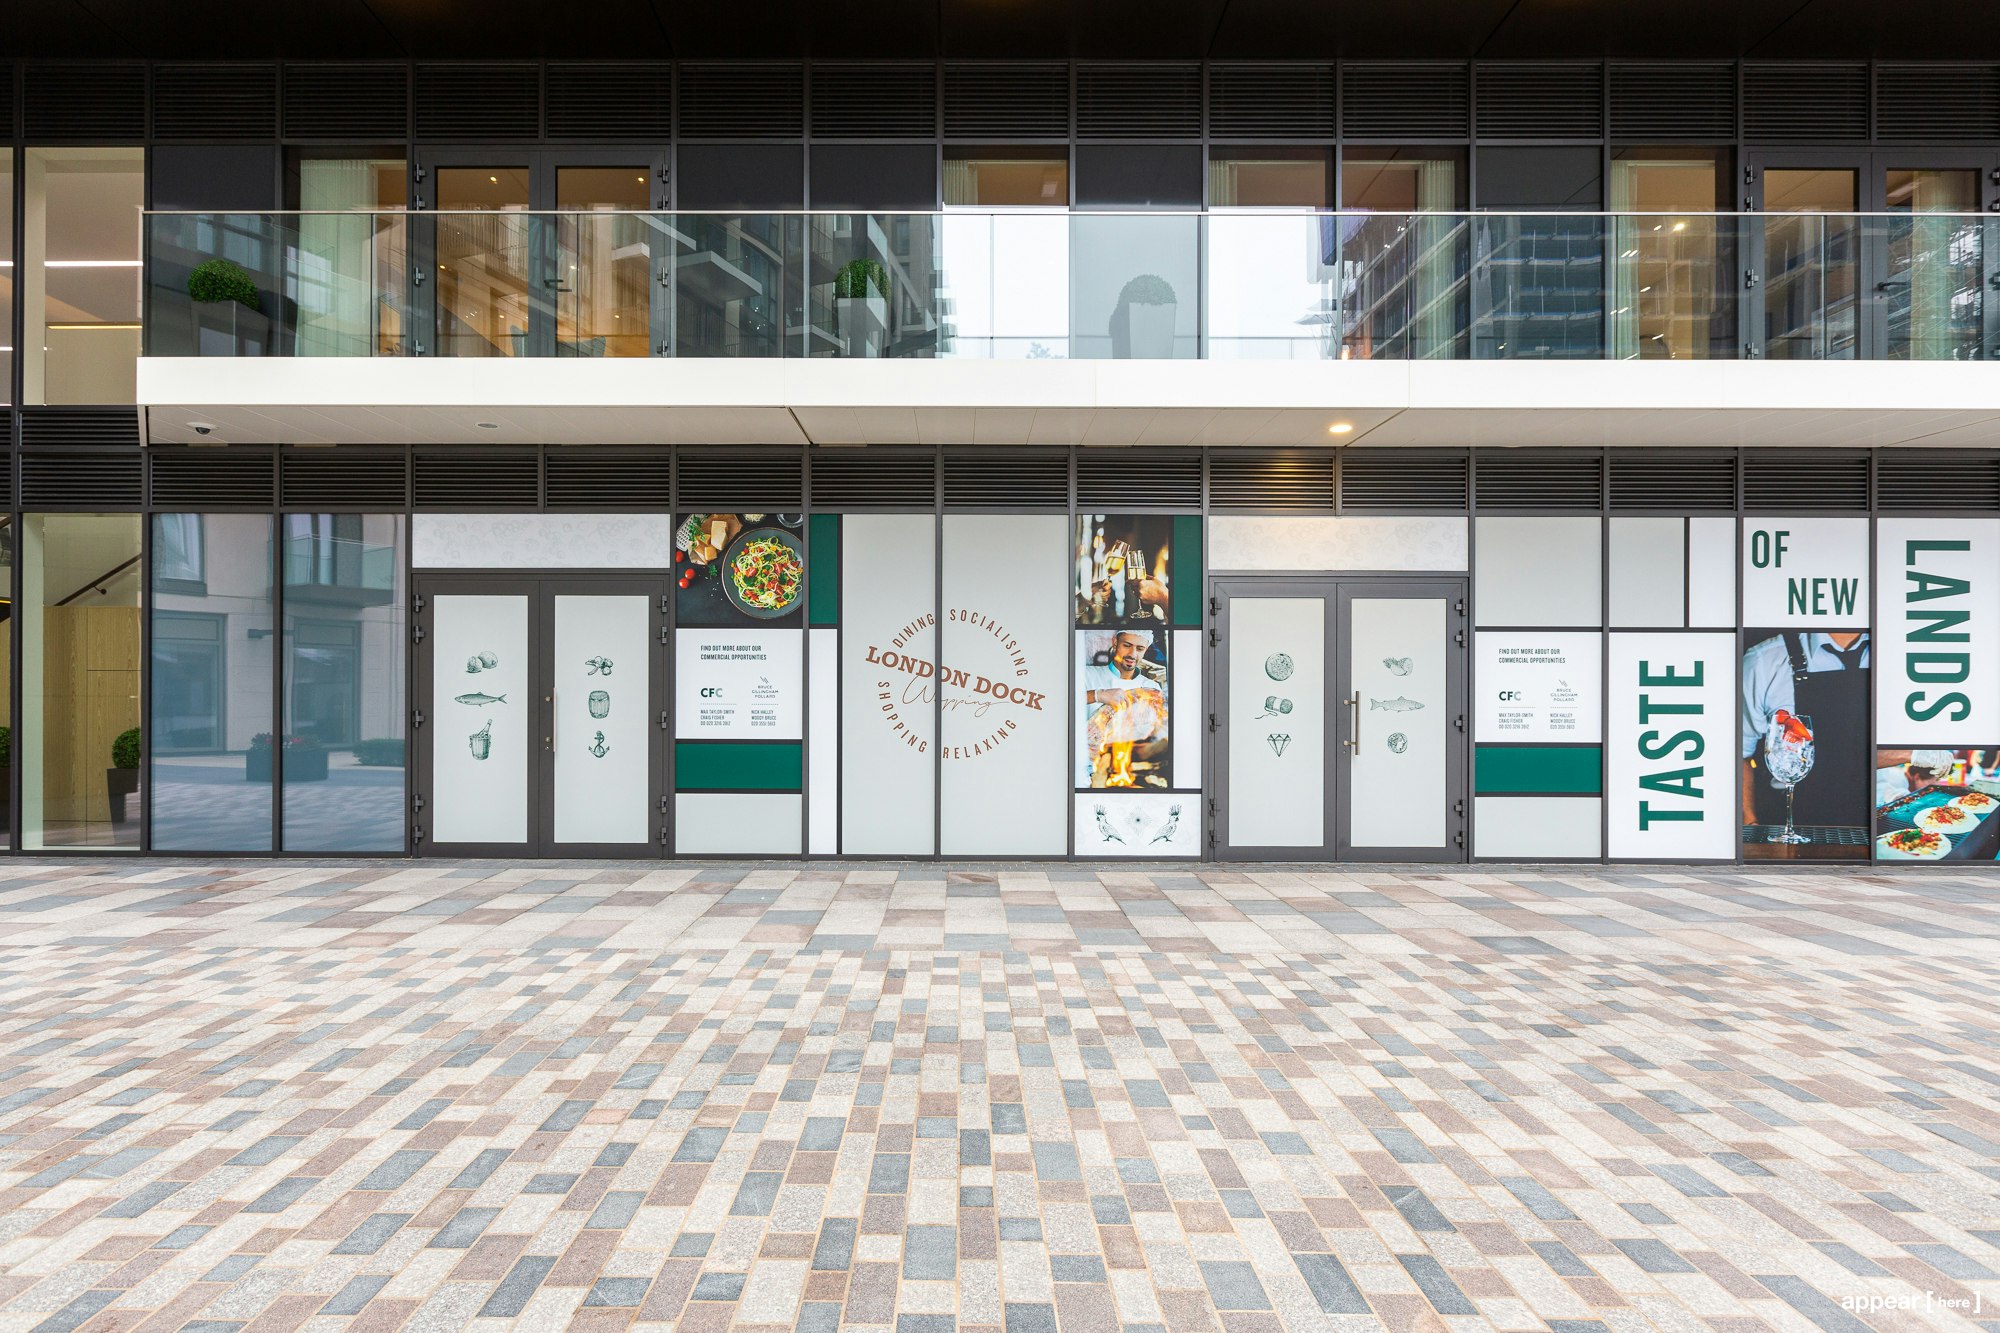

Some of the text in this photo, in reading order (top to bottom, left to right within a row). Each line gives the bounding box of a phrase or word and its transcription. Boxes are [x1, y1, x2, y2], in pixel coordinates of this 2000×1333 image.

[1751, 530, 1790, 569] OF
[1788, 578, 1858, 615] NEW
[892, 613, 935, 648] DINING
[949, 608, 1029, 677] SOCIALISING
[1905, 540, 1971, 722] LANDS
[700, 688, 723, 698] CFC
[865, 646, 1046, 711] LONDON DOCK
[1498, 691, 1521, 701] CFC
[877, 681, 927, 753] SHOPPING
[942, 719, 1017, 759] RELAXING
[1638, 660, 1705, 831] TASTE
